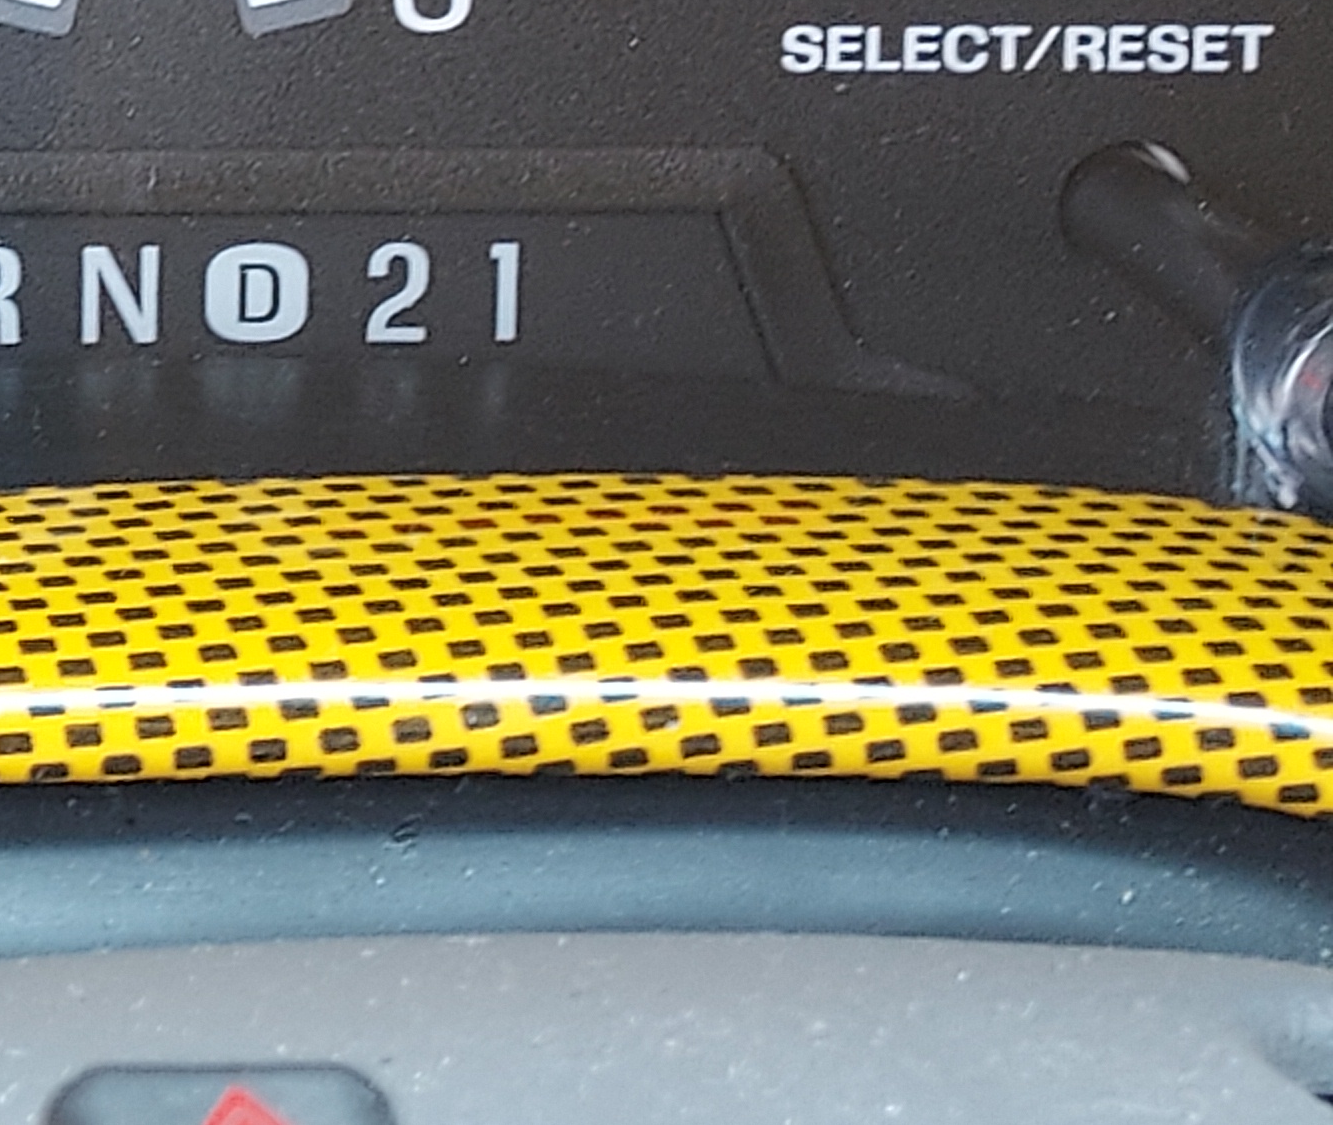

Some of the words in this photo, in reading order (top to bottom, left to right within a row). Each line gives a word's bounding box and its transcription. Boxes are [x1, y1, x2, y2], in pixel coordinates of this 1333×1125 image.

[780, 24, 1275, 73] SELECT/RESET
[81, 245, 160, 344] N
[366, 242, 430, 342] 2
[489, 242, 520, 341] 1
